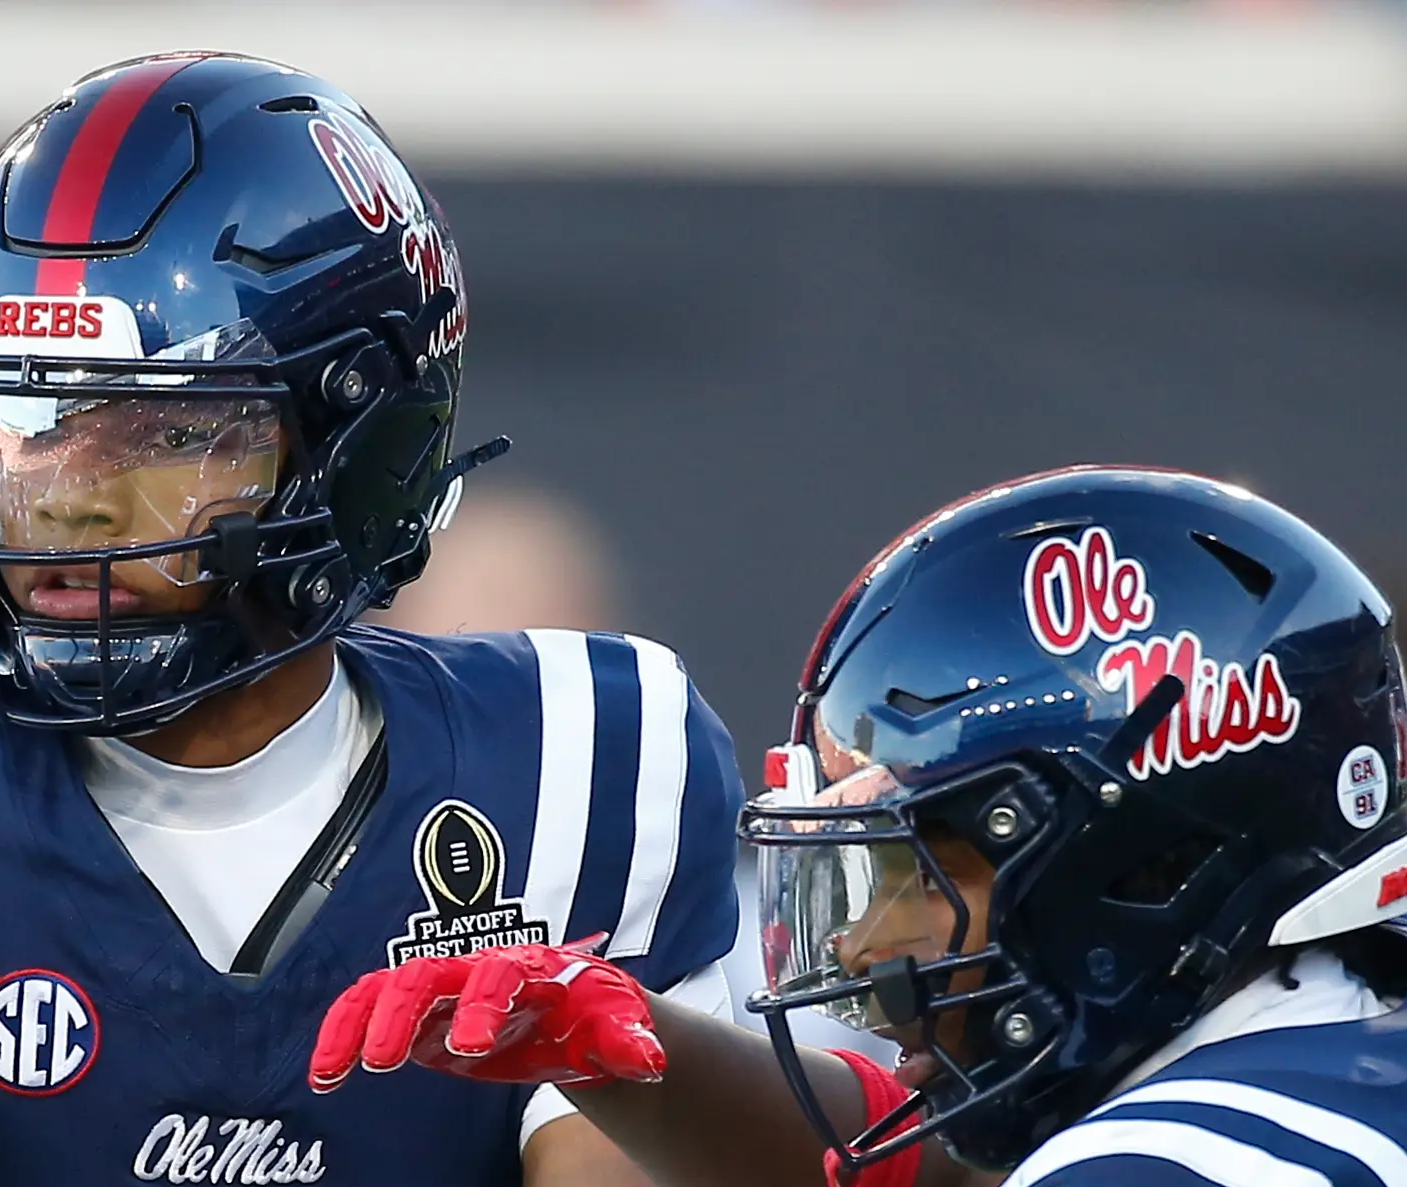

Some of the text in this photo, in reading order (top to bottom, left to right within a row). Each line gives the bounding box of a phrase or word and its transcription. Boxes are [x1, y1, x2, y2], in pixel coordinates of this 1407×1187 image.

[1023, 526, 1156, 656] Ole
[1096, 630, 1301, 781] Miss
[399, 927, 543, 965] FIRST ROUND
[420, 909, 517, 940] PLAYOFF
[133, 1114, 327, 1186] Ole Miss
